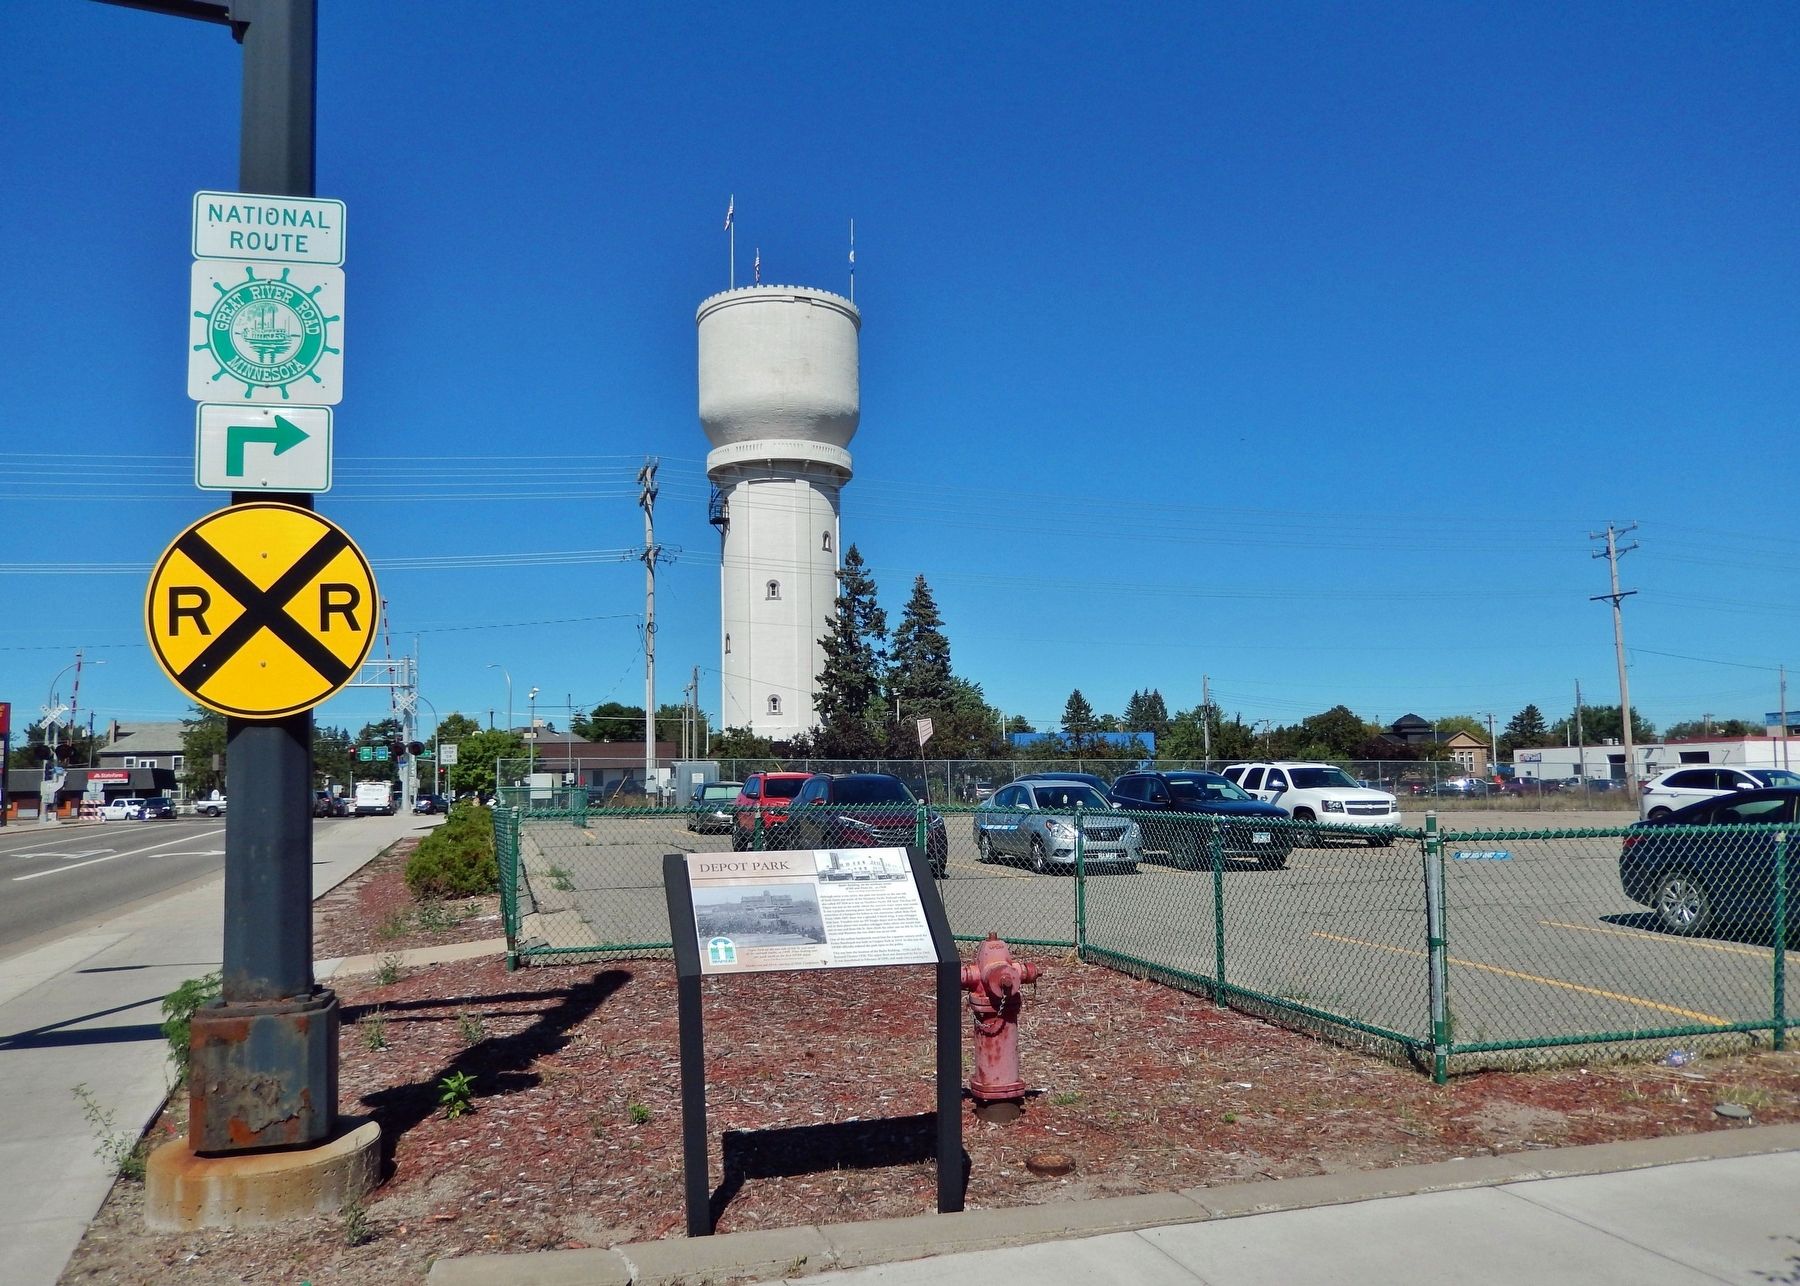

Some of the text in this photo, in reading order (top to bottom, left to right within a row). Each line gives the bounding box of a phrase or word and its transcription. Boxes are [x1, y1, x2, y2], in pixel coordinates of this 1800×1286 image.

[208, 203, 331, 229] NATIONAL
[230, 230, 309, 253] ROUTE
[214, 285, 321, 335] GREAT RIVER ROAD
[227, 355, 306, 381] MINNESOTA
[168, 583, 362, 637] R R
[700, 861, 790, 873] DEPOT PARK
